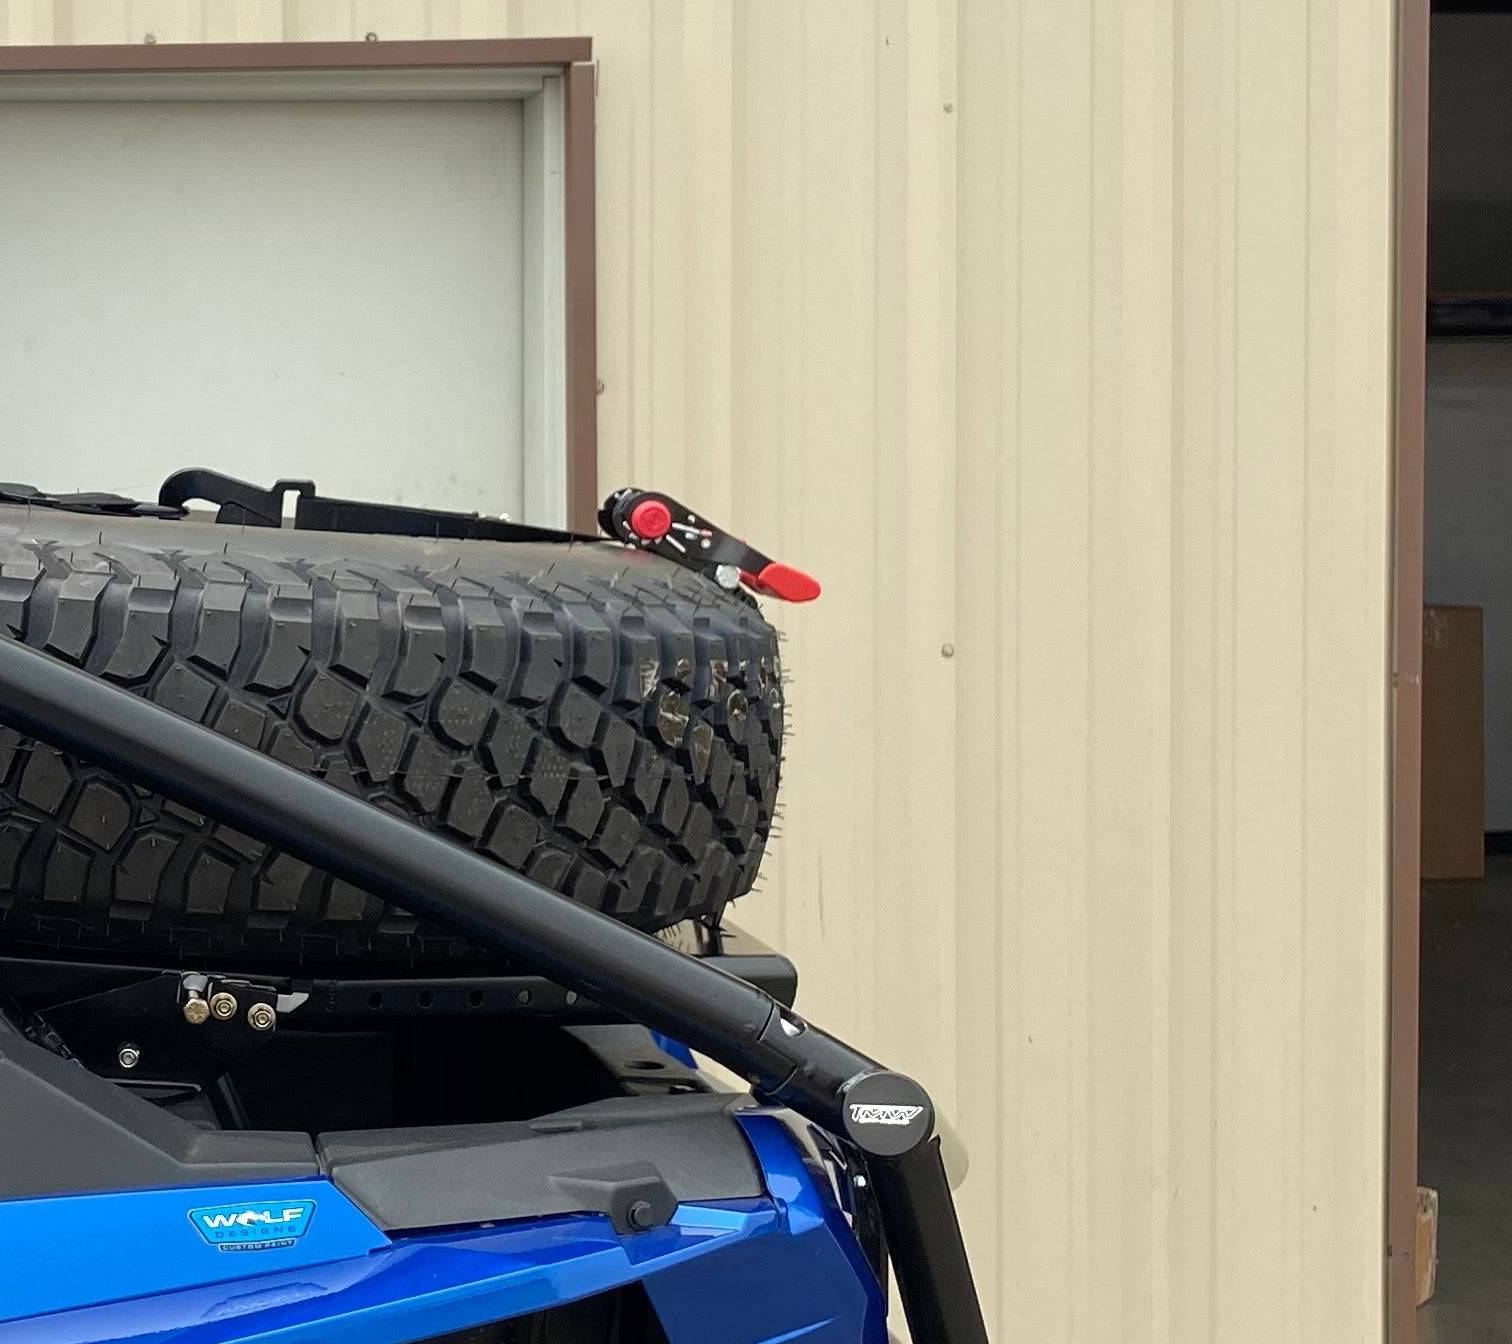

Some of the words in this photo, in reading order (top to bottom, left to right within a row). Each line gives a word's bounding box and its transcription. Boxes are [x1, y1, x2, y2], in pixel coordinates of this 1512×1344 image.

[202, 1207, 304, 1229] WOLF
[215, 1224, 297, 1239] DESIGNS
[221, 1241, 263, 1251] CUSTOM
